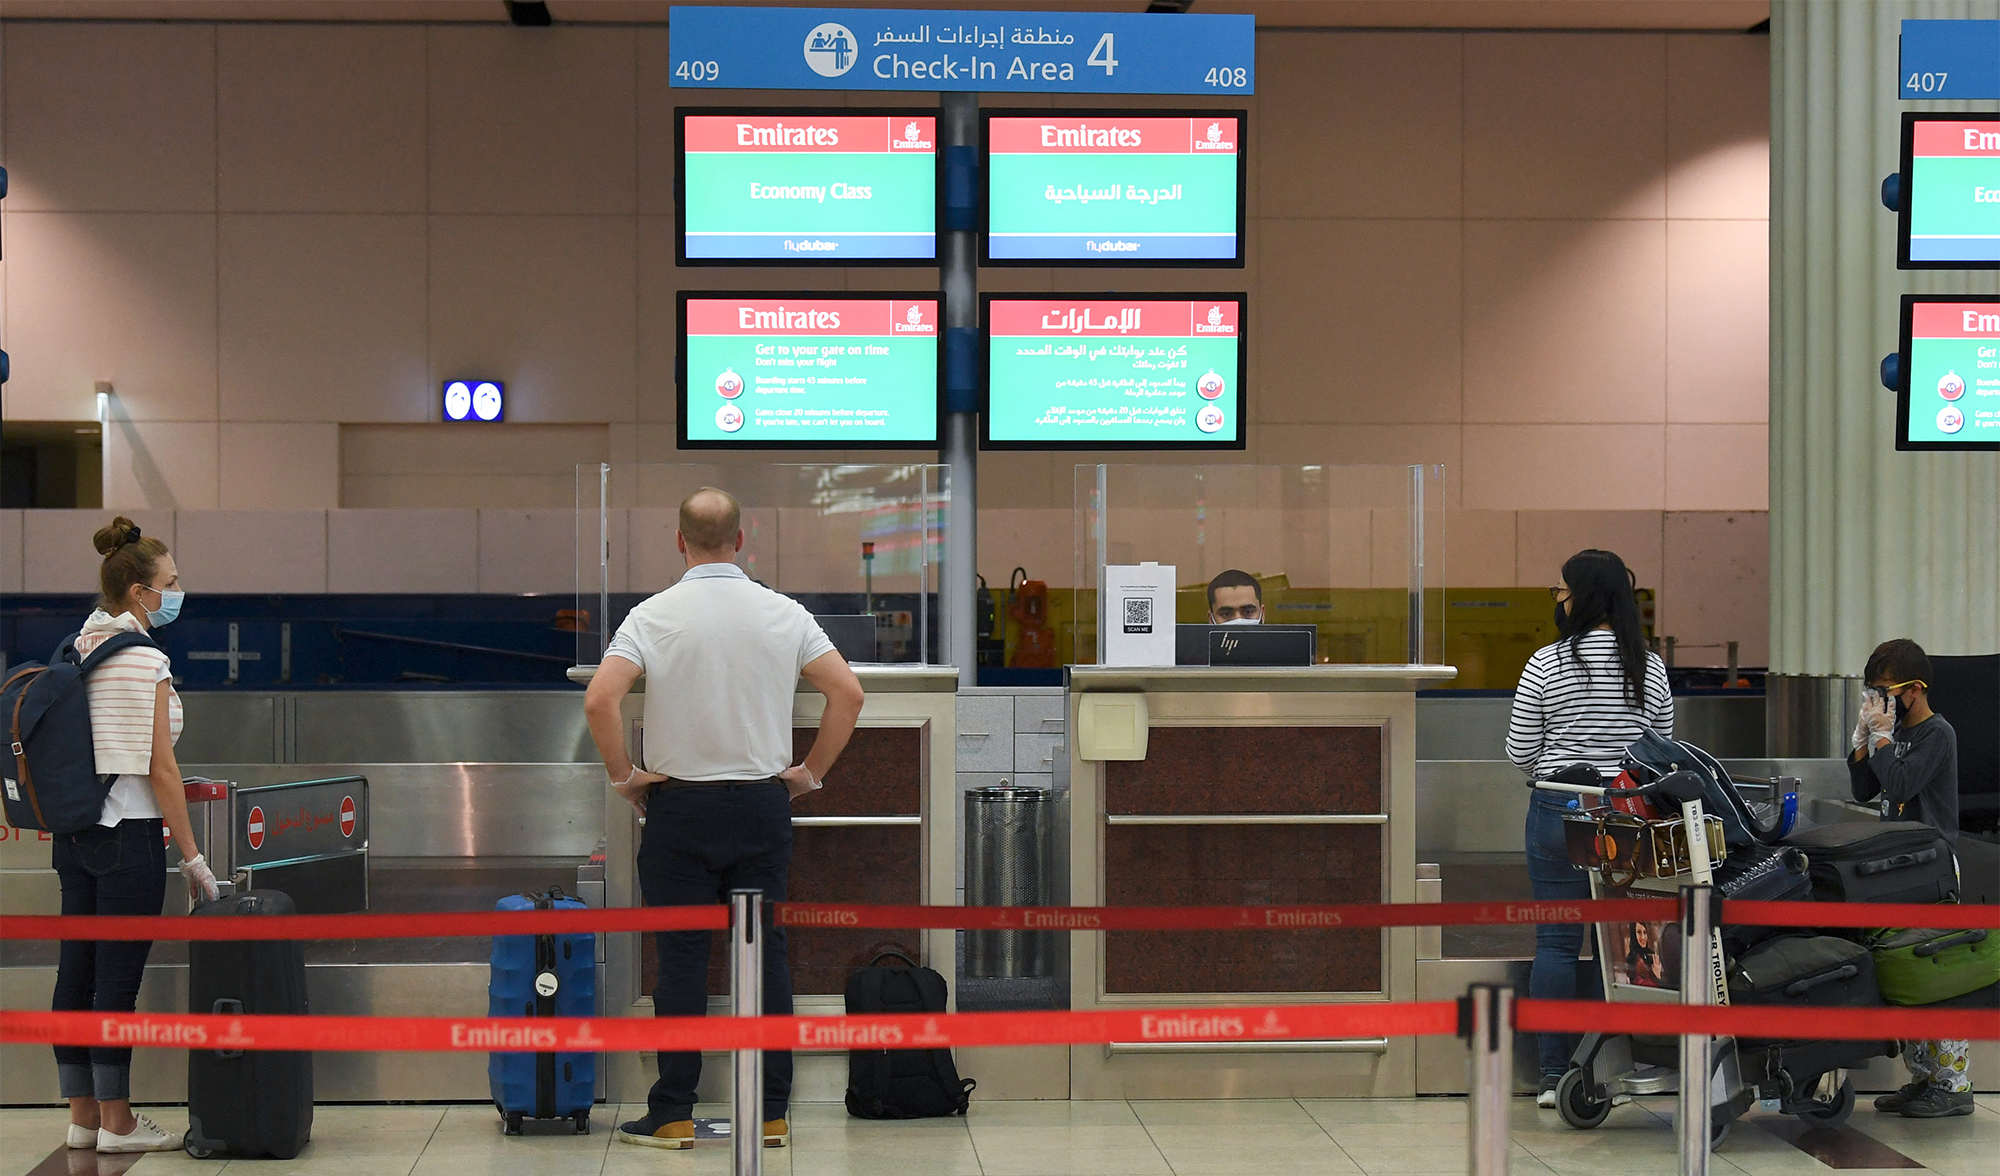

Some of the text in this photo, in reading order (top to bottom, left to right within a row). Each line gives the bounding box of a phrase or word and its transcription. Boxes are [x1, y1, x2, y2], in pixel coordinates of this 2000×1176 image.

[873, 25, 1075, 50] منطقة إجراءات السفر
[1086, 32, 1119, 76] 4
[675, 60, 720, 81] 409
[873, 54, 1074, 81] Check-In Area
[1204, 67, 1247, 88] 408
[1906, 72, 1948, 92] 407
[736, 122, 839, 146] Emirates
[1040, 123, 1142, 147] Emirates
[893, 139, 932, 149] Emirates
[1195, 140, 1234, 150] Emirates
[750, 182, 873, 203] Economy Class
[1044, 184, 1183, 205] الدرجة السياحية
[738, 306, 841, 330] Emirates
[1041, 308, 1142, 334] الإمارات
[895, 322, 934, 333] Emirates
[1196, 323, 1235, 334] Emirates
[755, 343, 890, 358] Get to your gate on time
[1016, 345, 1052, 356] المحدد
[1054, 345, 1087, 358] الوقت
[1089, 346, 1107, 361] في
[1147, 346, 1166, 356] عند
[1168, 344, 1188, 359] كن
[1977, 346, 1997, 358] Get
[755, 357, 837, 368] Don't miss your flight
[1180, 360, 1187, 368] لا
[1977, 360, 1997, 368] Don't
[724, 380, 735, 390] 45
[755, 376, 867, 386] Boarding starts 45 minutes before
[1088, 379, 1098, 387] 45
[1206, 382, 1216, 391] 45
[755, 386, 788, 395] departure
[755, 408, 774, 416] Gates
[794, 408, 804, 416] 20
[832, 408, 854, 416] before
[1118, 407, 1128, 415] 20
[1975, 410, 1993, 418] Gates
[724, 414, 735, 424] 20
[755, 418, 762, 426] If
[763, 418, 785, 427] you're
[812, 418, 828, 426] can't
[829, 418, 838, 426] let
[840, 419, 853, 427] you
[1205, 415, 1216, 424] 20
[1220, 632, 1238, 655] hp
[781, 906, 859, 925] Emirates
[1023, 909, 1100, 927] Emirates
[1265, 909, 1342, 926] Emirates
[1506, 904, 1582, 922] Emirates
[1712, 952, 1726, 1006] TROLLEY
[101, 1017, 208, 1045] Emirates
[798, 1019, 904, 1045] Emirates
[1141, 1012, 1245, 1039] Emirates
[450, 1021, 557, 1048] Emirates
